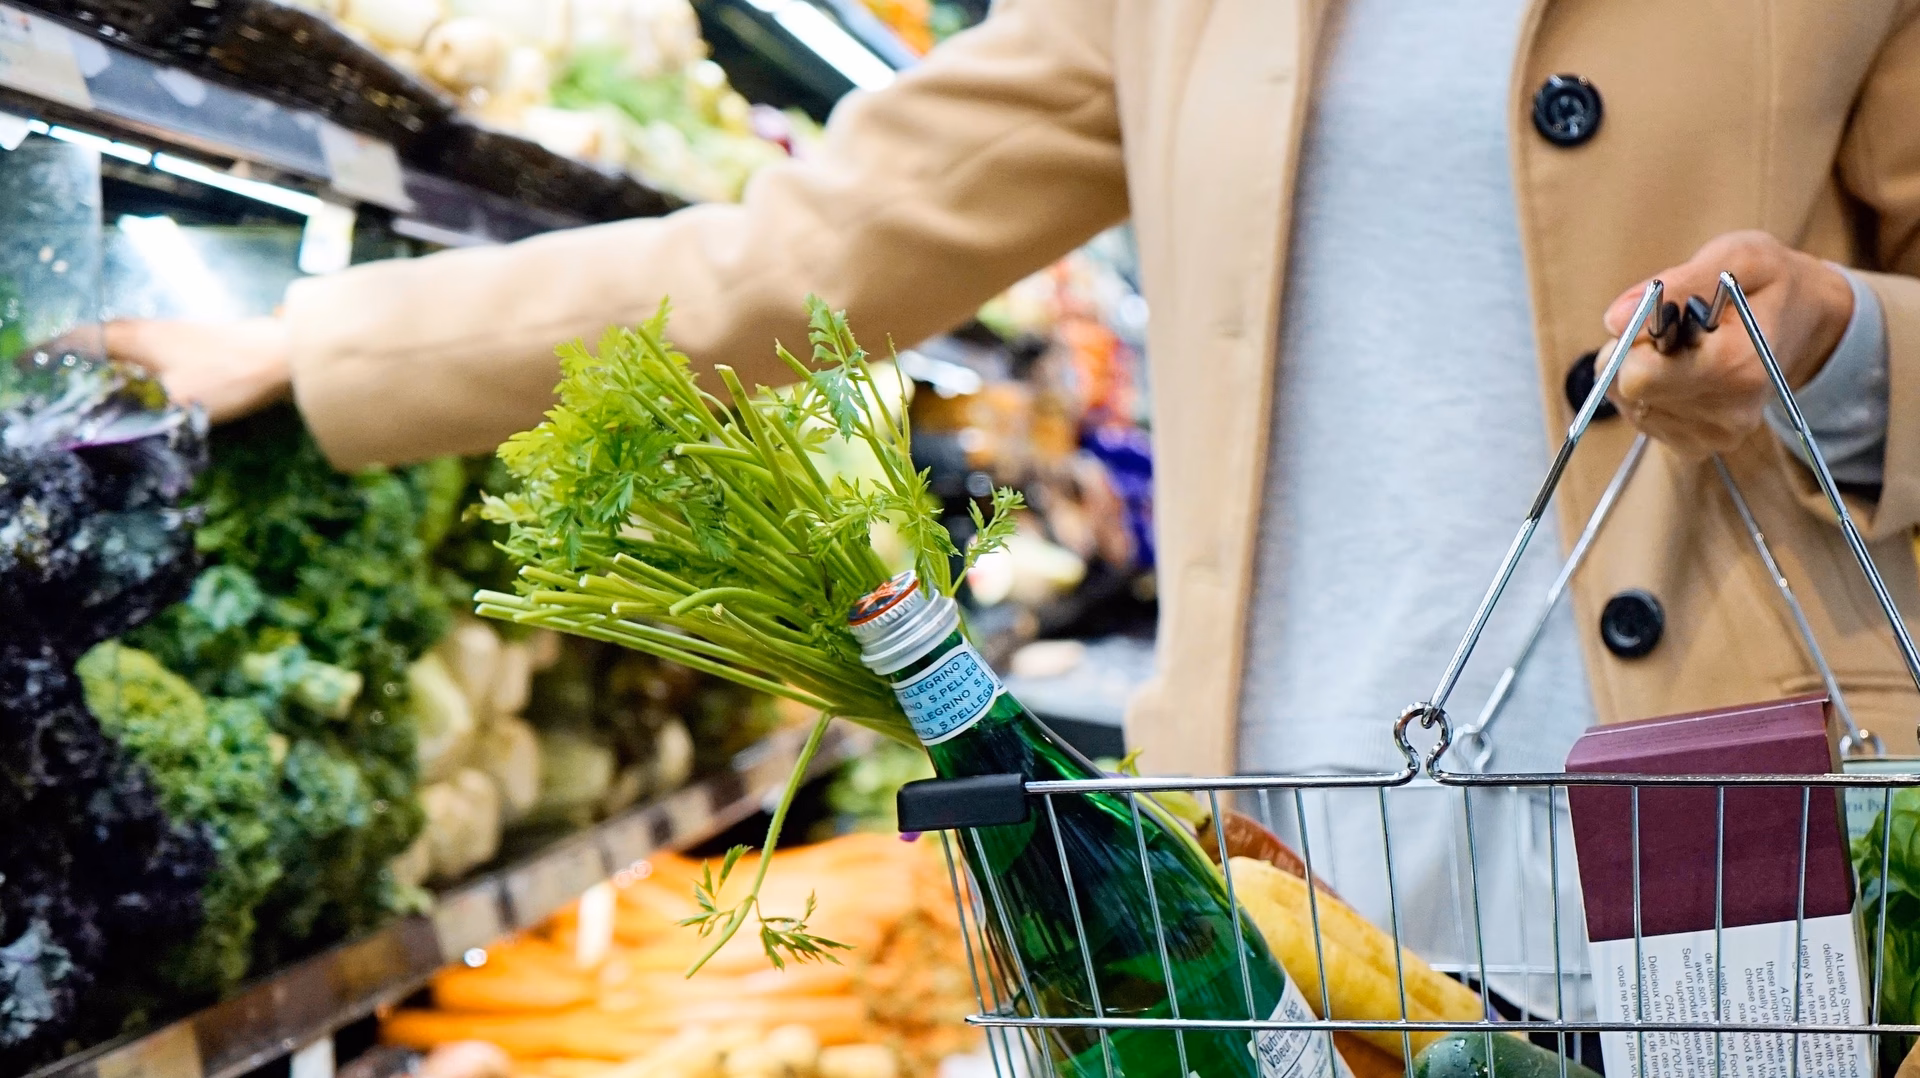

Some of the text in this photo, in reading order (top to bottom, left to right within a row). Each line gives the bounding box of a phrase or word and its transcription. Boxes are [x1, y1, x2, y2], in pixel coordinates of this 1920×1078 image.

[903, 661, 960, 699] ELLEGRINO
[913, 689, 971, 724] ELLEGRINO
[1682, 947, 1693, 970] Seul
[1705, 952, 1713, 965] de
[1822, 943, 1834, 985] delicious
[1835, 952, 1844, 963] At
[1617, 965, 1627, 988] vous
[1685, 972, 1694, 984] un
[1744, 967, 1756, 1002] cheese
[1756, 967, 1765, 983] but
[1765, 960, 1775, 987] these
[1837, 964, 1848, 996] Lesley
[1620, 989, 1629, 1001] ne
[1686, 985, 1699, 1018] produit
[1695, 961, 1704, 984] avec
[1702, 1011, 1709, 1023] en
[1758, 985, 1769, 1010] really
[1780, 986, 1789, 994] A
[1805, 981, 1814, 998] her
[1648, 955, 1660, 998] Délicieux
[1654, 1000, 1662, 1013] au
[1661, 1052, 1670, 1069] ces
[1749, 1004, 1757, 1014] or
[1769, 989, 1780, 1021] unique
[1808, 1000, 1817, 1025] team
[1818, 994, 1827, 1010] are
[1824, 1041, 1834, 1061] with
[1266, 1039, 1292, 1069] Valeur
[1626, 1042, 1637, 1062] plus
[1648, 1040, 1657, 1054] de
[1681, 1033, 1694, 1066] pouvait
[1766, 1039, 1776, 1065] when
[1802, 1040, 1814, 1074] scratch
[1815, 1051, 1824, 1067] the
